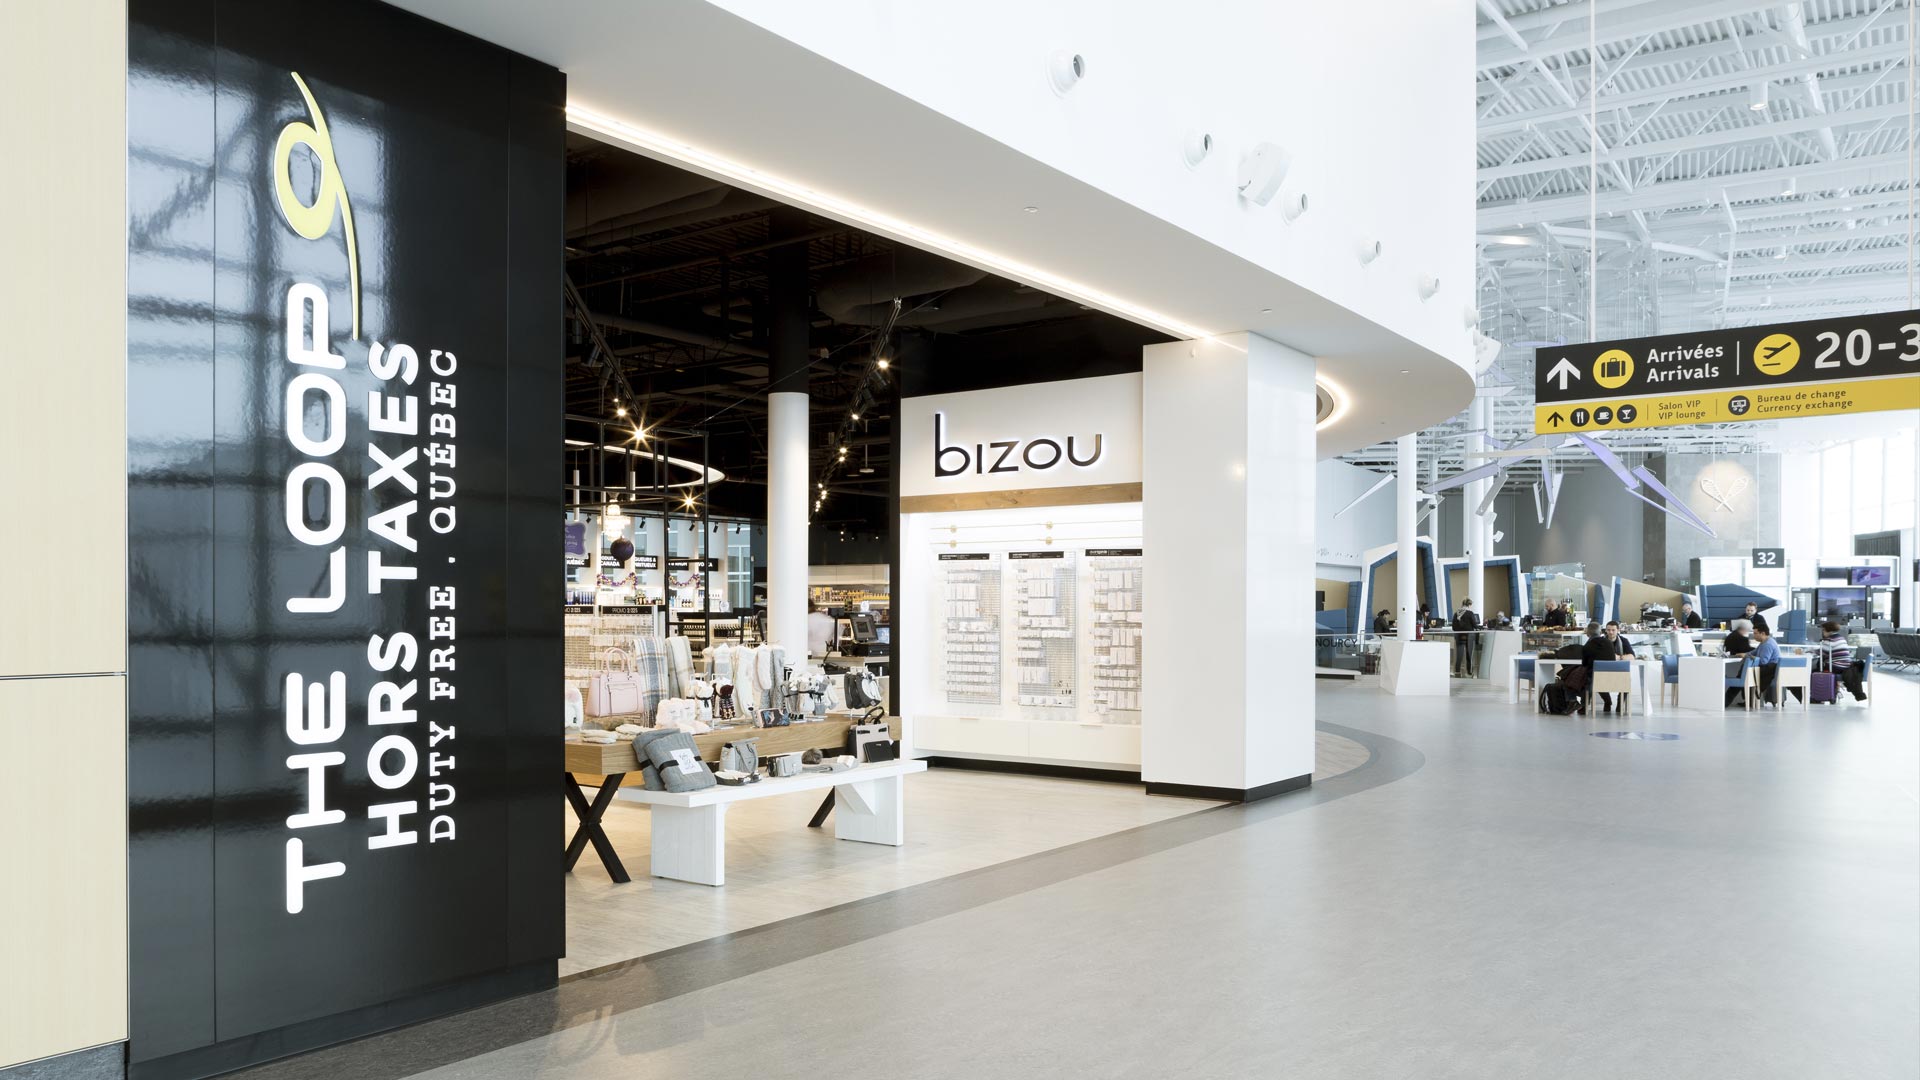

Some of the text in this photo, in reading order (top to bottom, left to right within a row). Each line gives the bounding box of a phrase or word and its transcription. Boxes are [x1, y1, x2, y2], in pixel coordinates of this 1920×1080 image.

[1646, 343, 1724, 364] Arrivées
[1646, 362, 1720, 383] Arrivals
[1658, 399, 1701, 411] Salon VIP
[1757, 389, 1847, 403] Bureau de change
[1757, 399, 1853, 413] Currency exchange
[1658, 410, 1706, 420] VIP lounge
[423, 349, 457, 534] QUÉBEC
[934, 413, 1103, 477] bizou
[1757, 551, 1777, 566] 32
[286, 282, 347, 914] THE LOOP
[367, 341, 419, 850] HORS TAXES
[429, 585, 456, 700] FREE
[429, 721, 456, 843] DUTY
